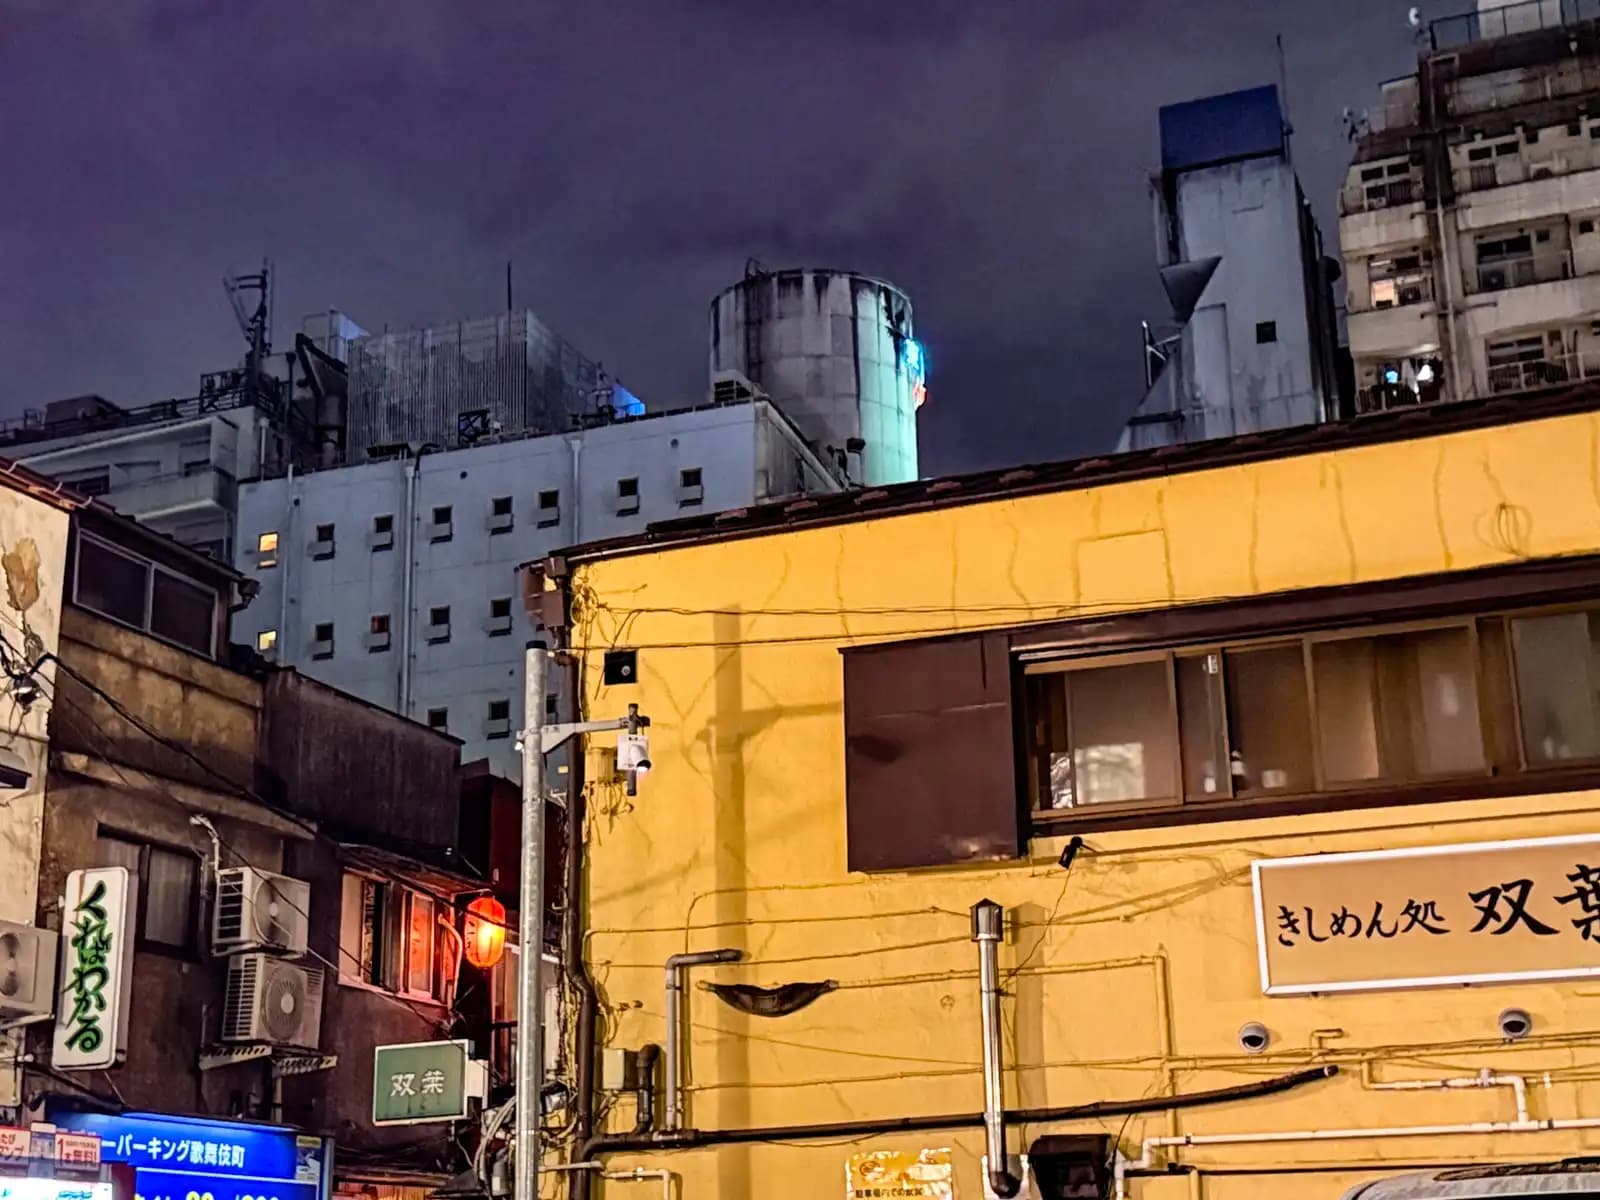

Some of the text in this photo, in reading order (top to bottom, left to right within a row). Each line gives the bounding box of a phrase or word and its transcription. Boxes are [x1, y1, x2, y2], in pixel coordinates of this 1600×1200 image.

[1277, 898, 1451, 947] きしめん処
[390, 1069, 446, 1097] 双葉
